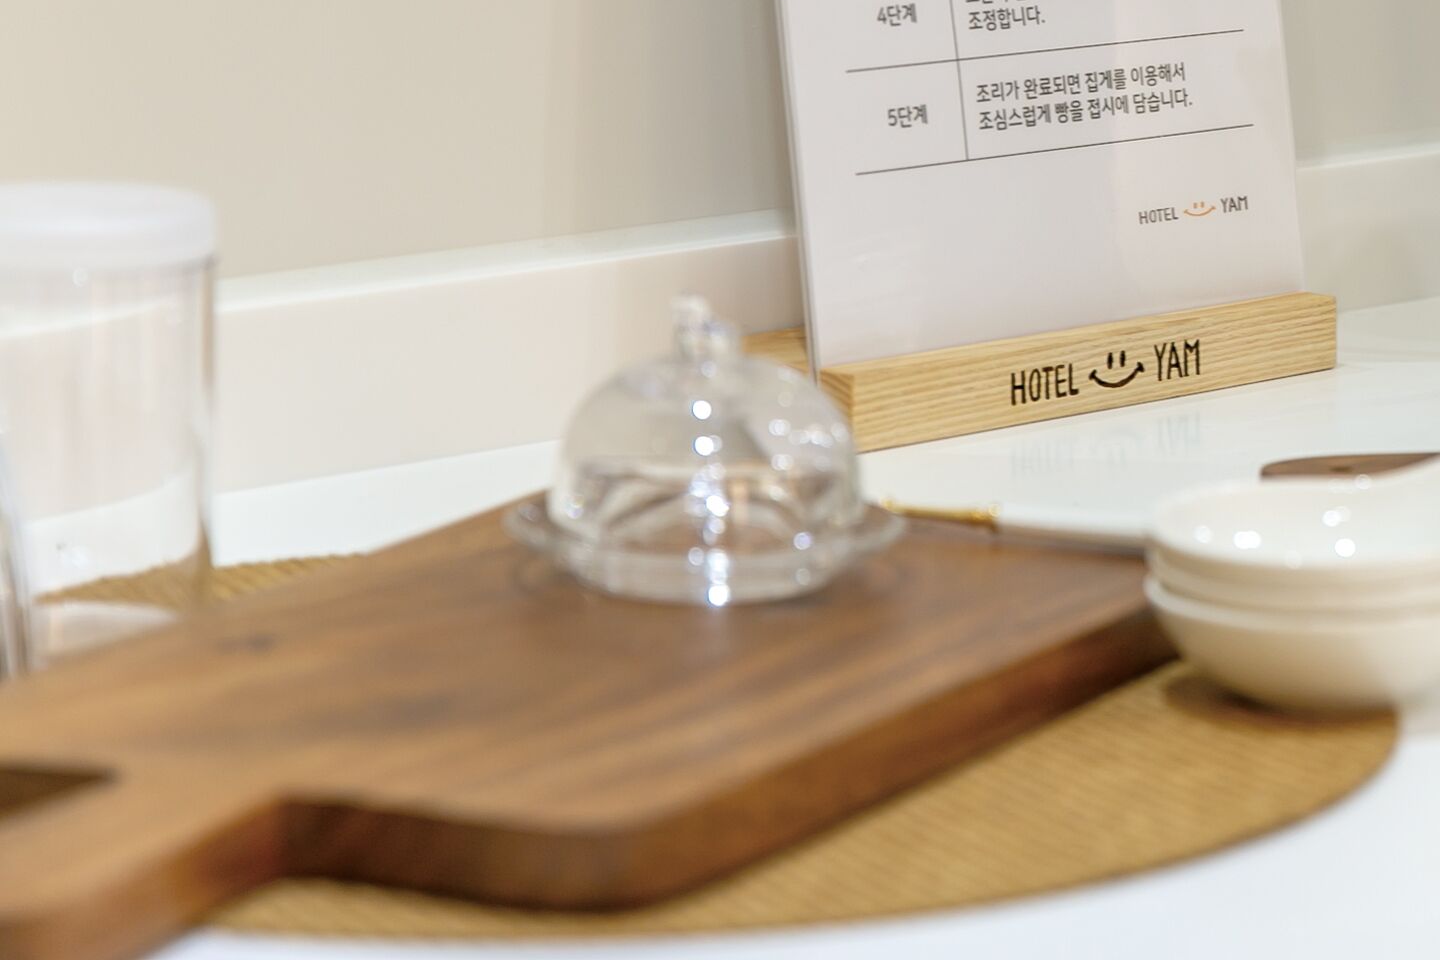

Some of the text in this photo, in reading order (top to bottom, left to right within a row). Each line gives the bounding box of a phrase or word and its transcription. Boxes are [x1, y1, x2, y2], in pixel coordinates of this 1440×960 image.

[877, 3, 917, 27] 4단계
[968, 5, 1046, 32] 조정합니다.
[976, 62, 1186, 103] 조리가 완료되면 집게를 이용해서
[887, 104, 928, 129] 5단계
[977, 88, 1193, 131] 조심스럽게 빵을 접시에 담습니다.
[1138, 195, 1249, 225] HOTEL YAM
[1010, 339, 1201, 406] HOTEL YAM
